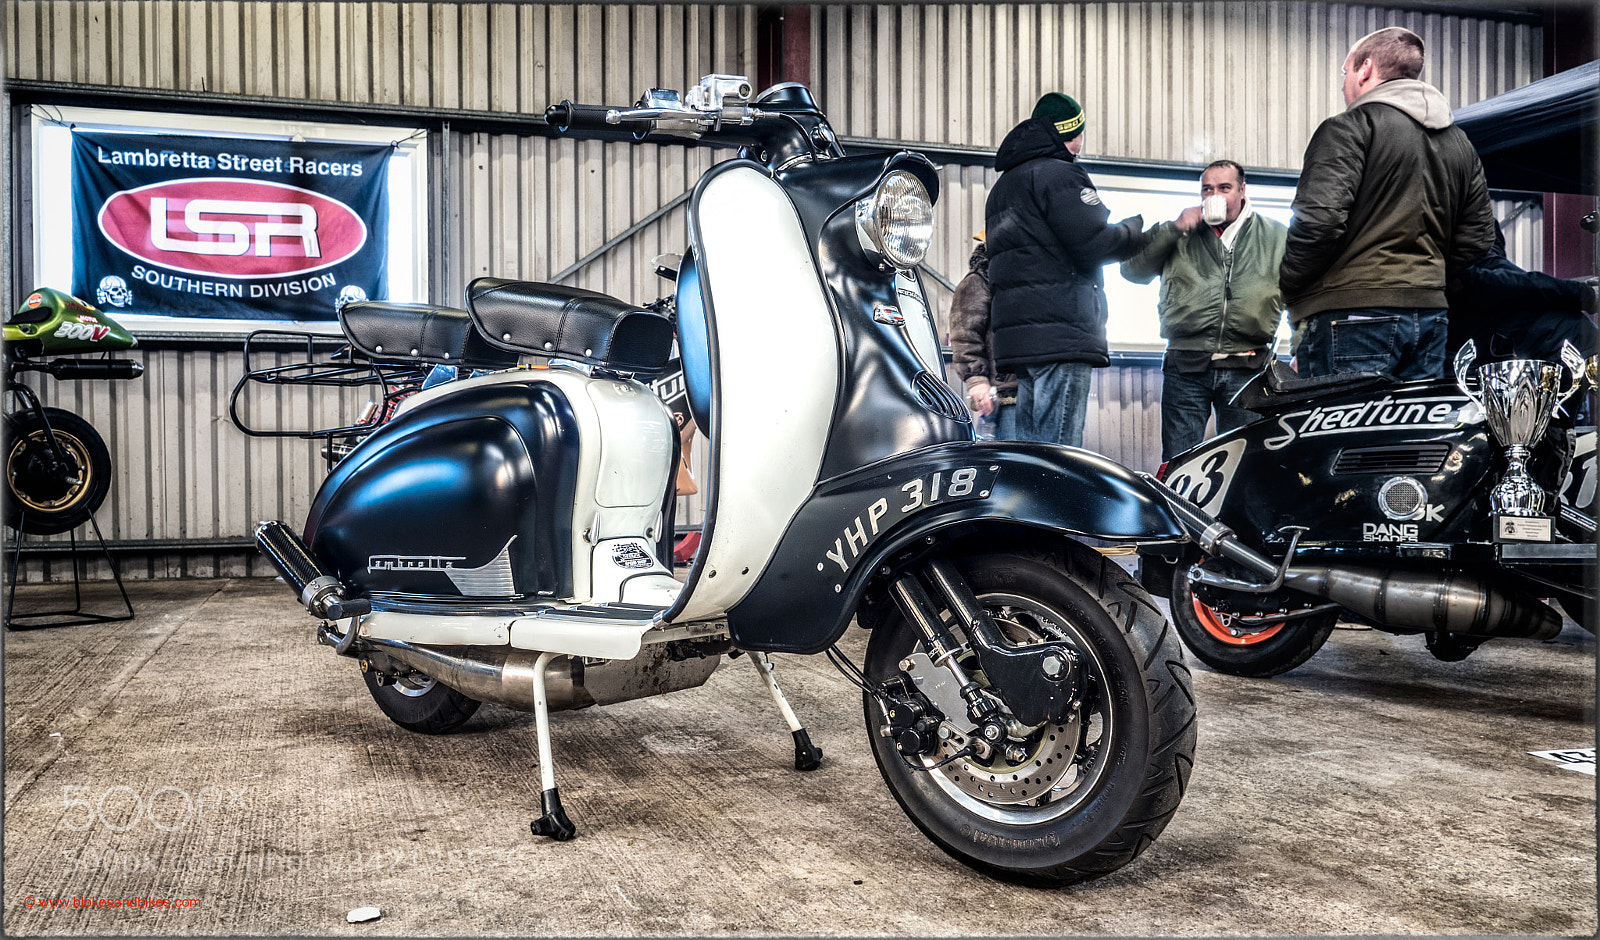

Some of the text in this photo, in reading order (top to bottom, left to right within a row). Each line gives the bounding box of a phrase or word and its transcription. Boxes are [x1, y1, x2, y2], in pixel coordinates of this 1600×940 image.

[98, 146, 363, 177] Lambretta Street Racers
[150, 197, 322, 258] LSR
[131, 265, 336, 298] SOUTHERN DIVISION
[54, 321, 111, 342] 300V
[826, 468, 977, 573] YHP 318
[1363, 523, 1418, 536] DANG
